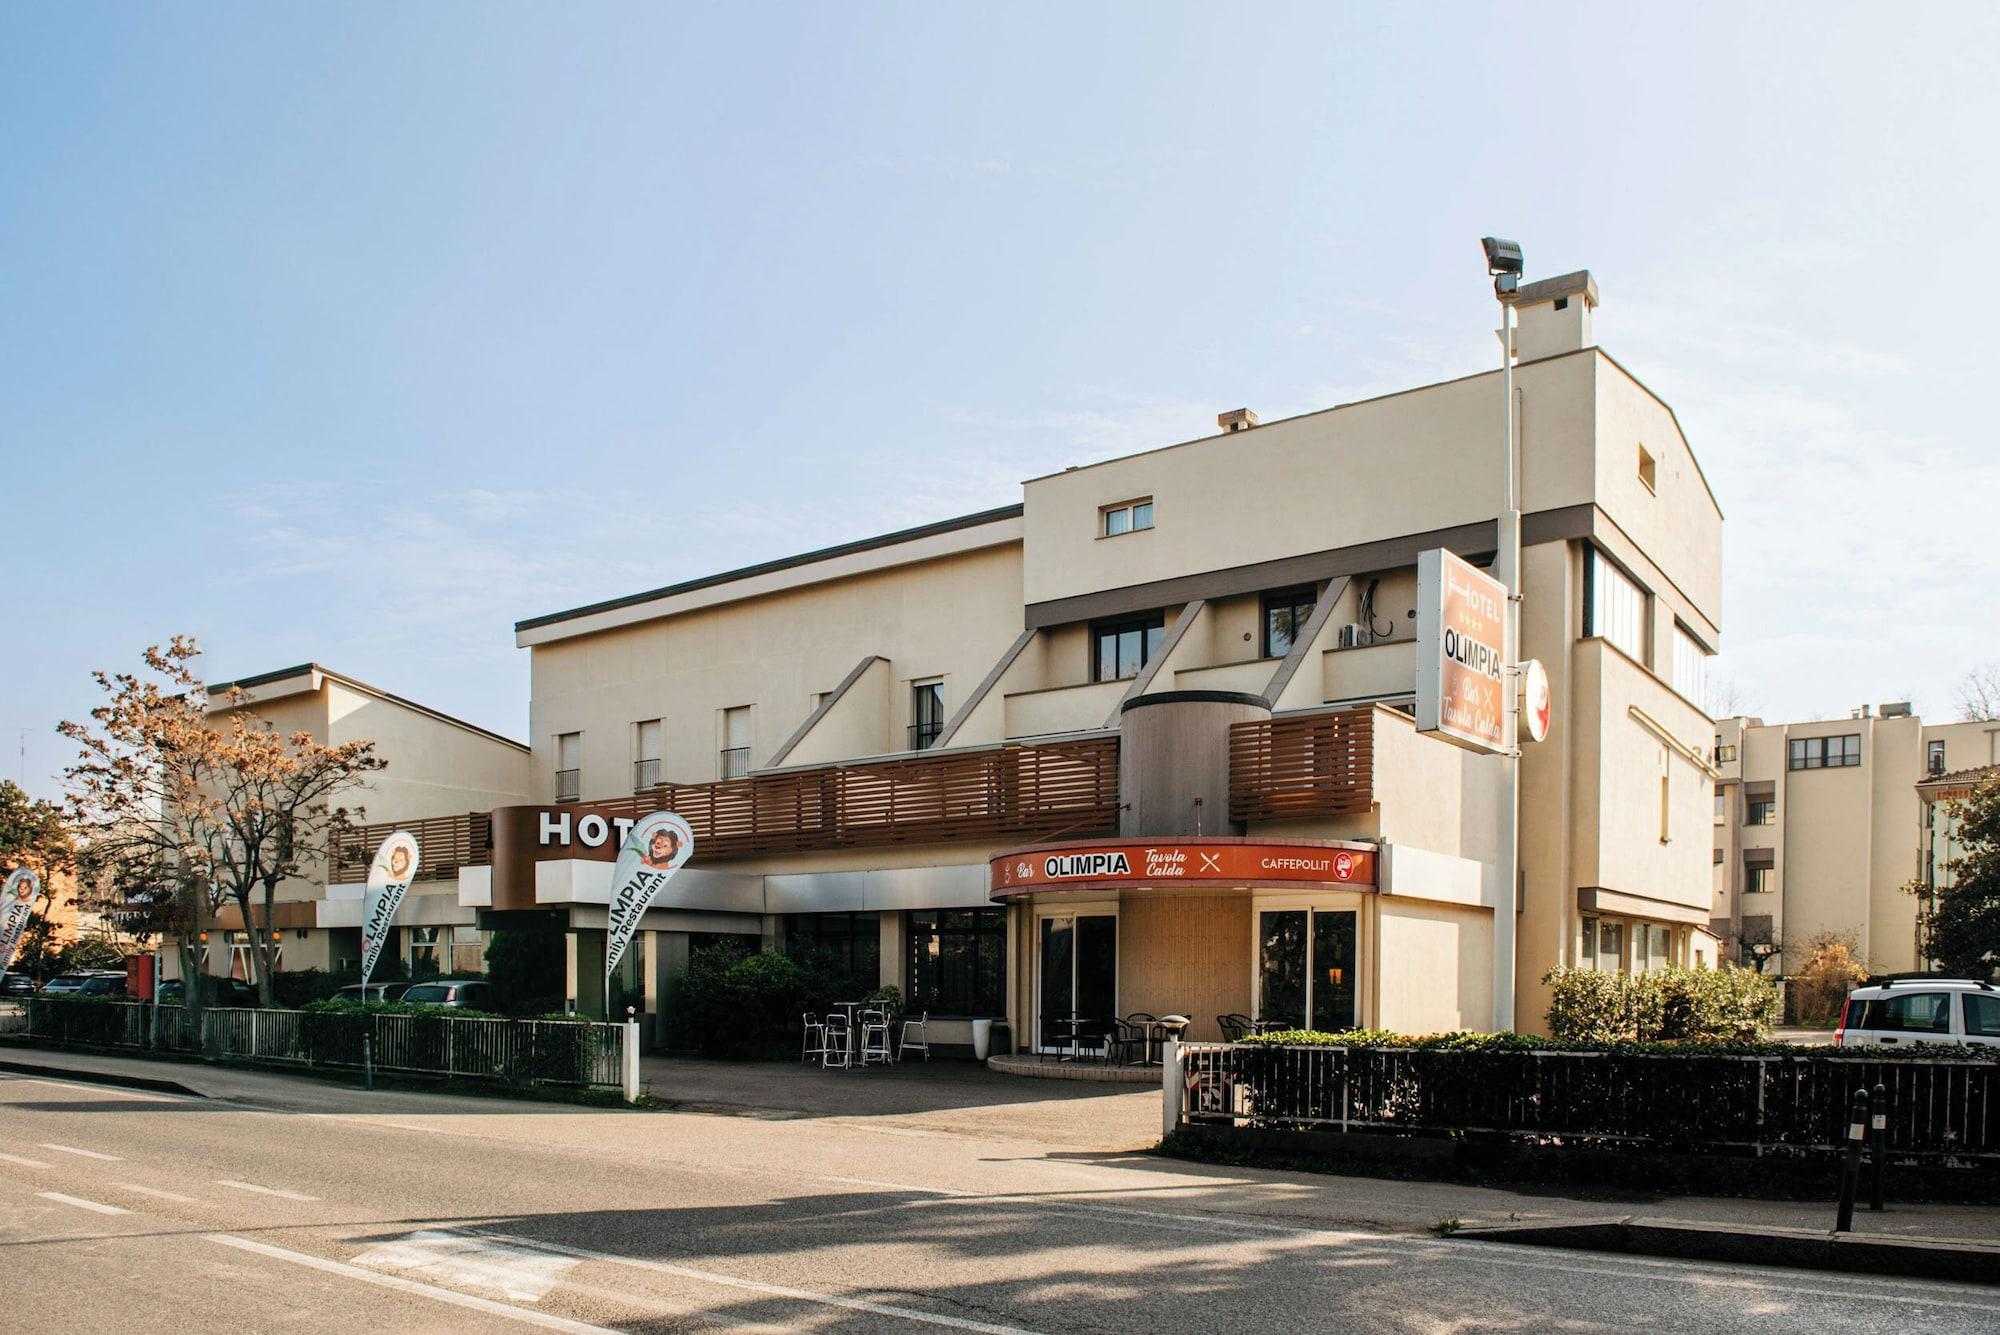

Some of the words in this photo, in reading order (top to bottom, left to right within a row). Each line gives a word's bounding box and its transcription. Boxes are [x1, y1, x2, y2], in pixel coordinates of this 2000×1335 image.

[1447, 563, 1500, 624] HOTEL
[1445, 628, 1500, 680] OLIMPIA
[540, 811, 637, 848] HOT
[1016, 862, 1036, 879] Bar
[1045, 853, 1130, 877] OLIMPIA
[1145, 849, 1188, 863] Tavola
[1145, 863, 1186, 877] Calda
[1261, 857, 1330, 871] CAFFEPOLI.IT
[362, 883, 397, 954] OLIMPIA
[609, 870, 654, 937] LIMPIA
[619, 872, 667, 936] Restaurant
[362, 943, 381, 978] Family
[376, 883, 406, 941] Restaurant
